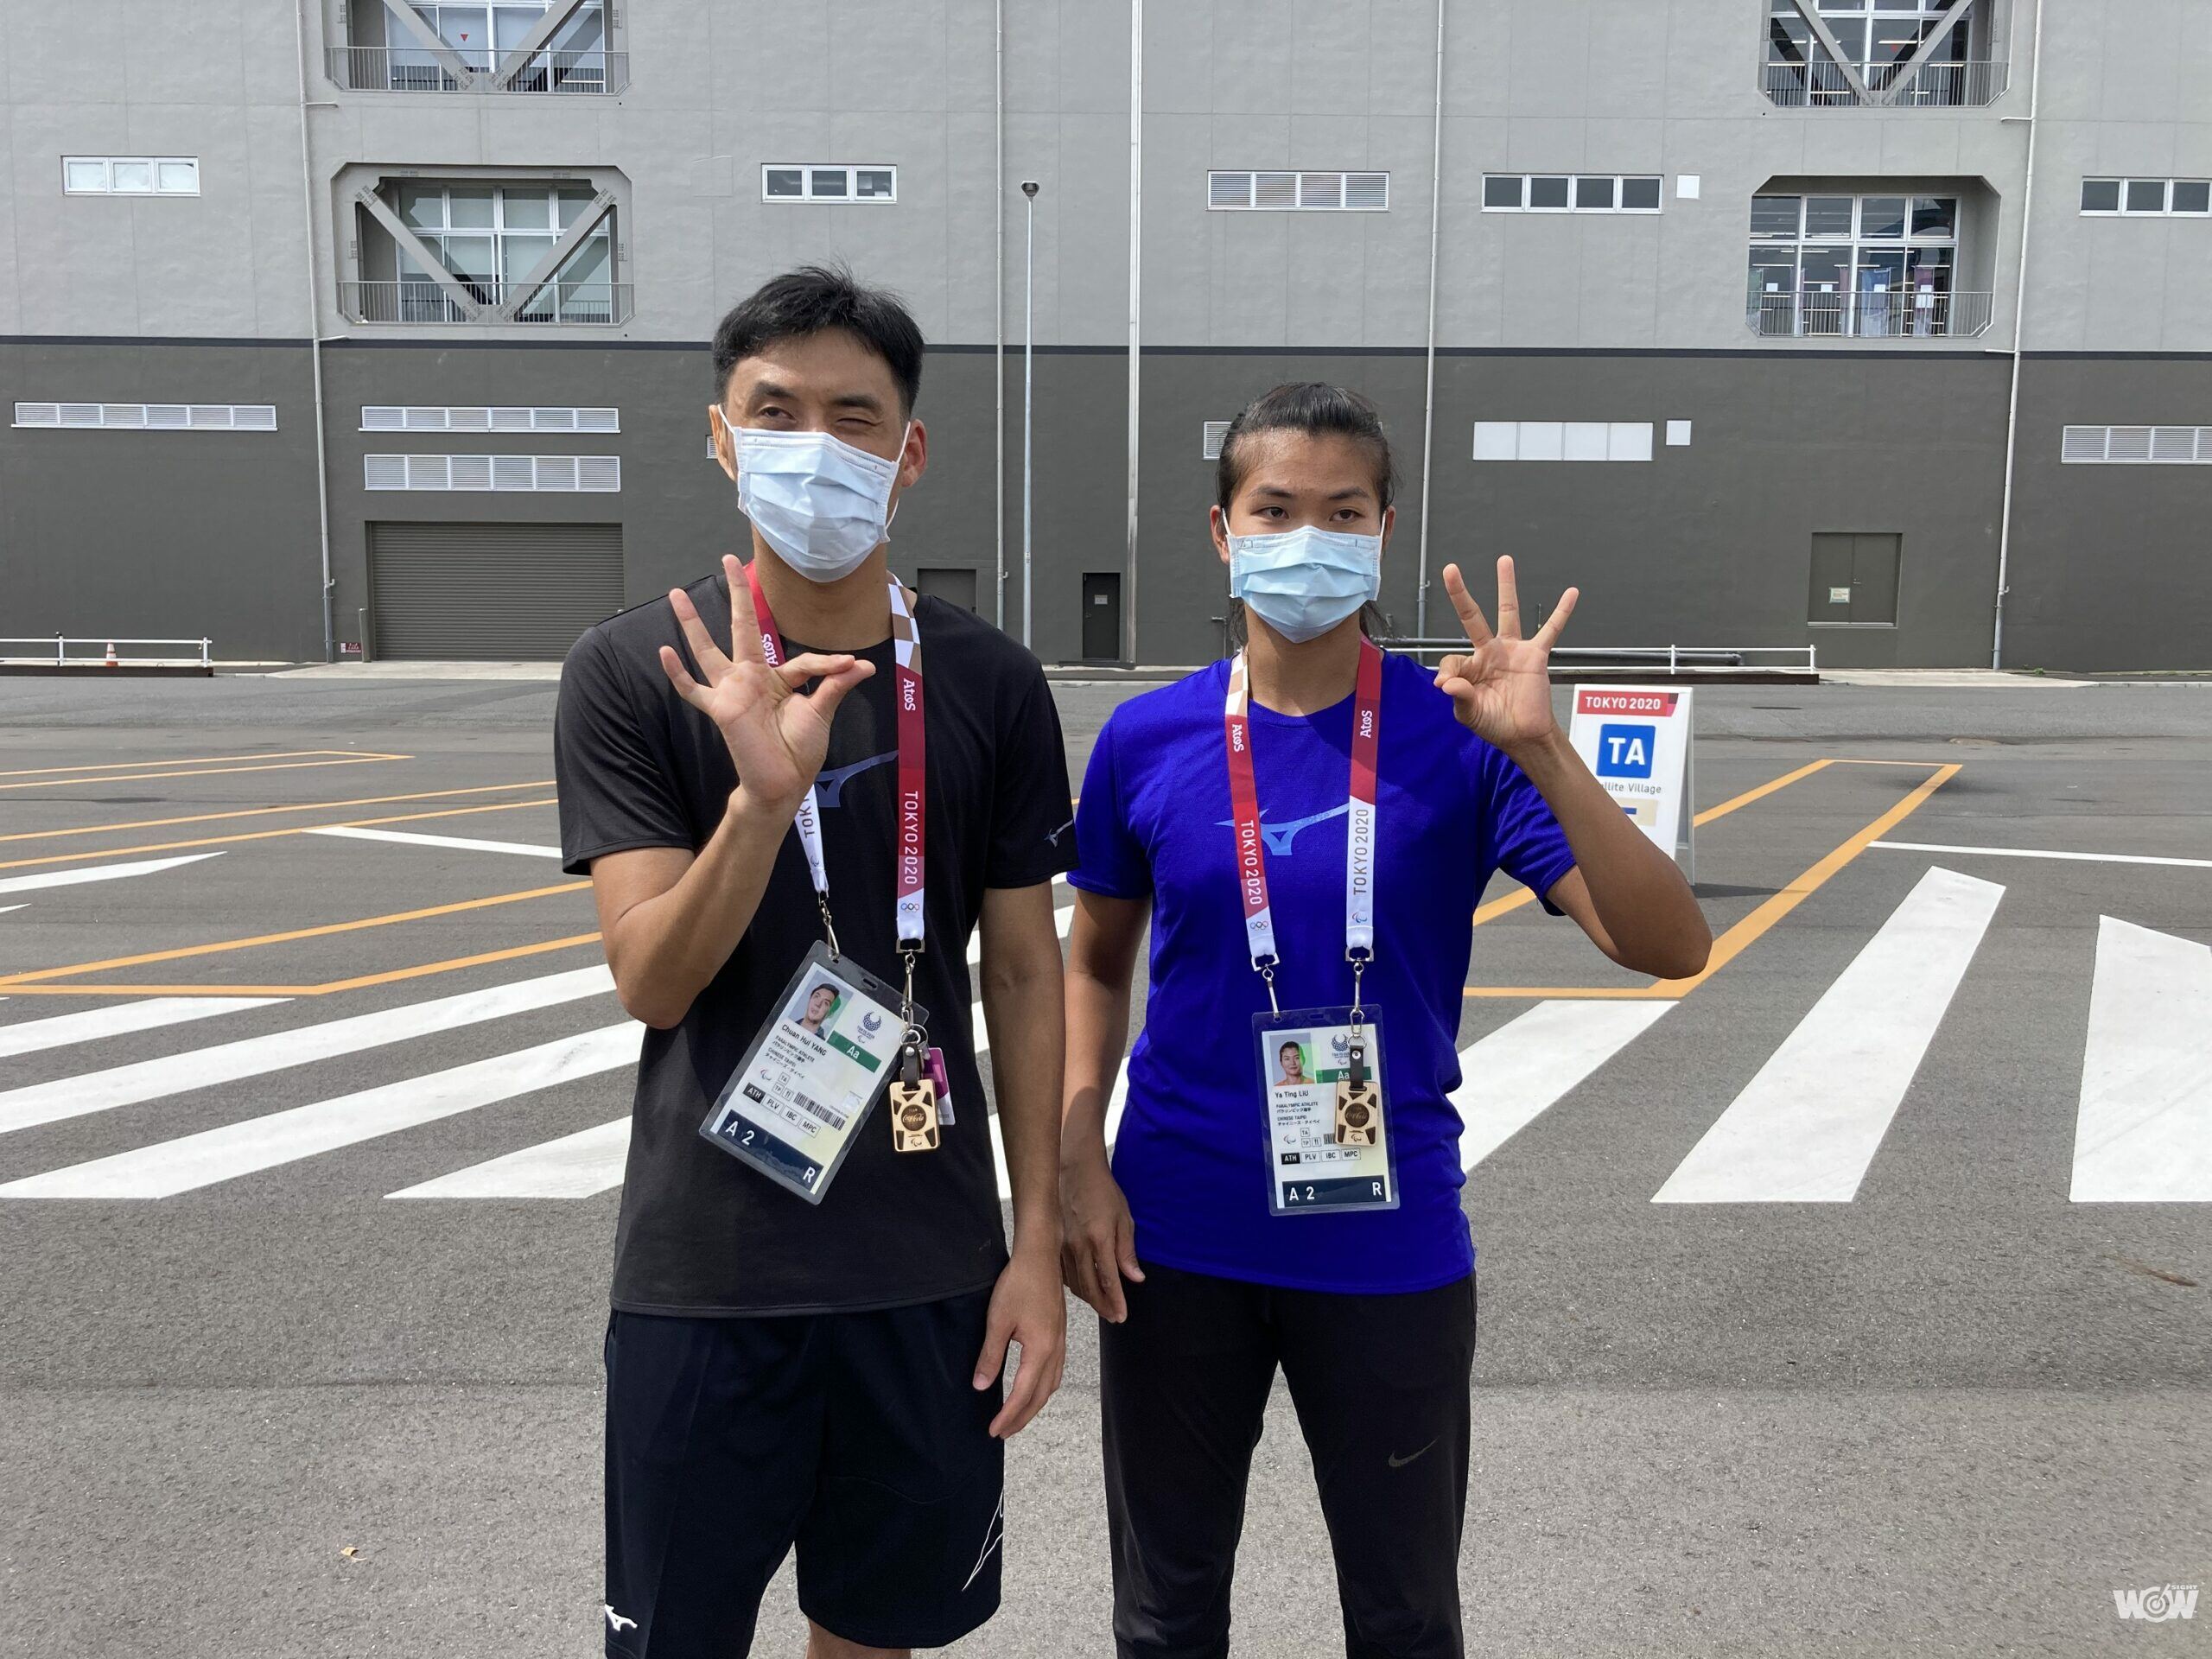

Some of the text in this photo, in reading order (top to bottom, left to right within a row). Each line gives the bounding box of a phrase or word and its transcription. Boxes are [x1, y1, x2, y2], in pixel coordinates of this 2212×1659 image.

[761, 633, 779, 665] Atos
[903, 677, 916, 711] Atos
[1585, 696, 1661, 709] TOKYO 2020
[1231, 723, 1244, 753] Atos
[1360, 709, 1373, 739] Atos
[1607, 737, 1645, 766] TA
[1628, 783, 1662, 795] Village
[904, 791, 918, 885] TOKYO 2020
[1353, 809, 1369, 895] TOKYO 2020
[1241, 819, 1262, 905] TOKYO 2020
[781, 1024, 800, 1039] Chuan
[811, 1042, 827, 1057] YANG
[846, 1045, 861, 1059] Aa
[1338, 1071, 1350, 1080] Aa
[747, 1086, 817, 1133] ATH PLV IBC MPC
[725, 1121, 816, 1183] A 2 R
[1289, 1181, 1382, 1201] A 2 R
